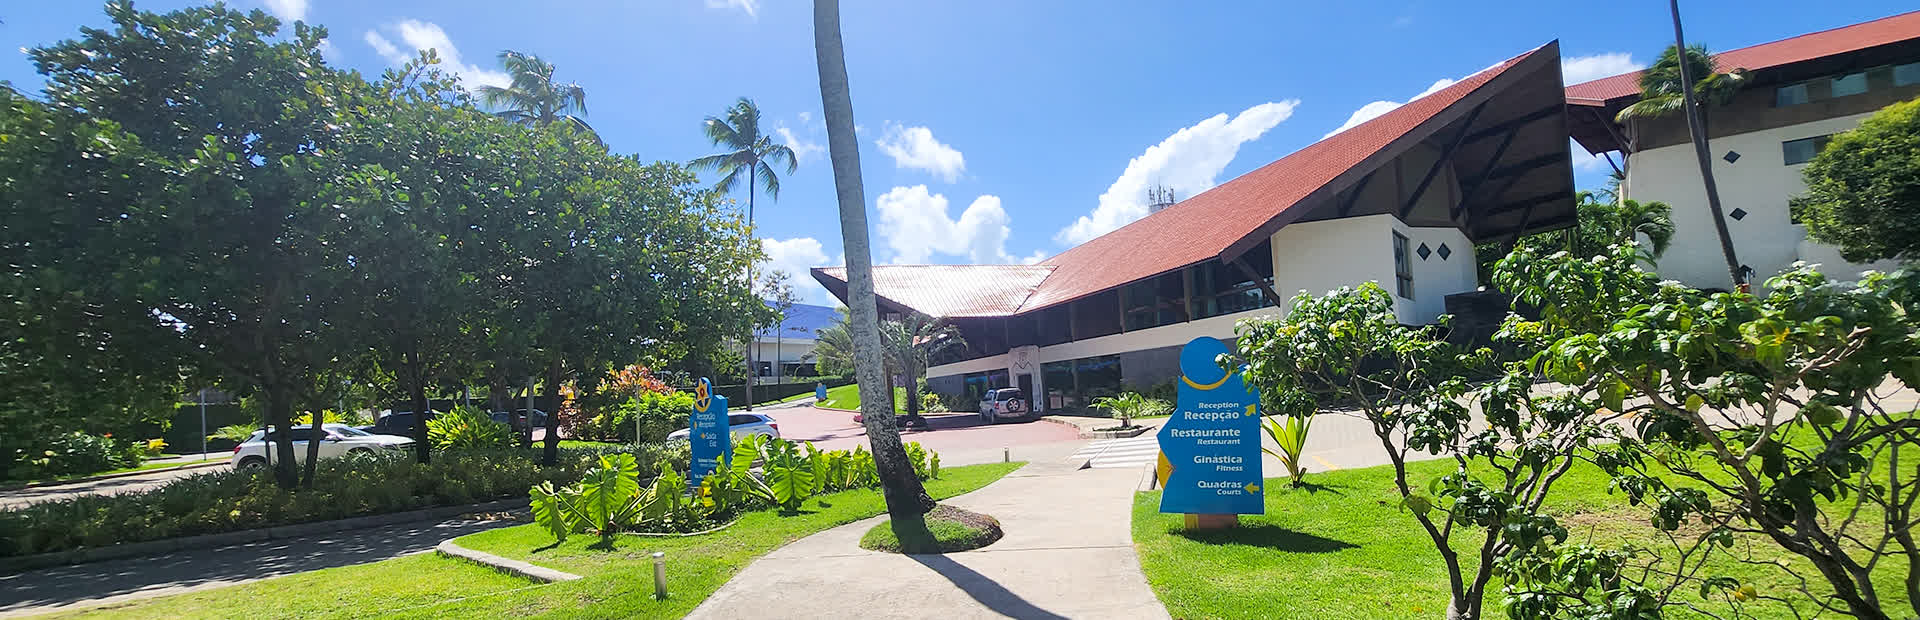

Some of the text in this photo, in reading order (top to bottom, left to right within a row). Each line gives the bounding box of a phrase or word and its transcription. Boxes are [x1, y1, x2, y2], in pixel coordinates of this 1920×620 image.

[1184, 410, 1240, 421] Recepção
[1171, 429, 1240, 437] Restaurante
[1193, 455, 1242, 463] Ginástica
[1197, 480, 1242, 489] Quadras
